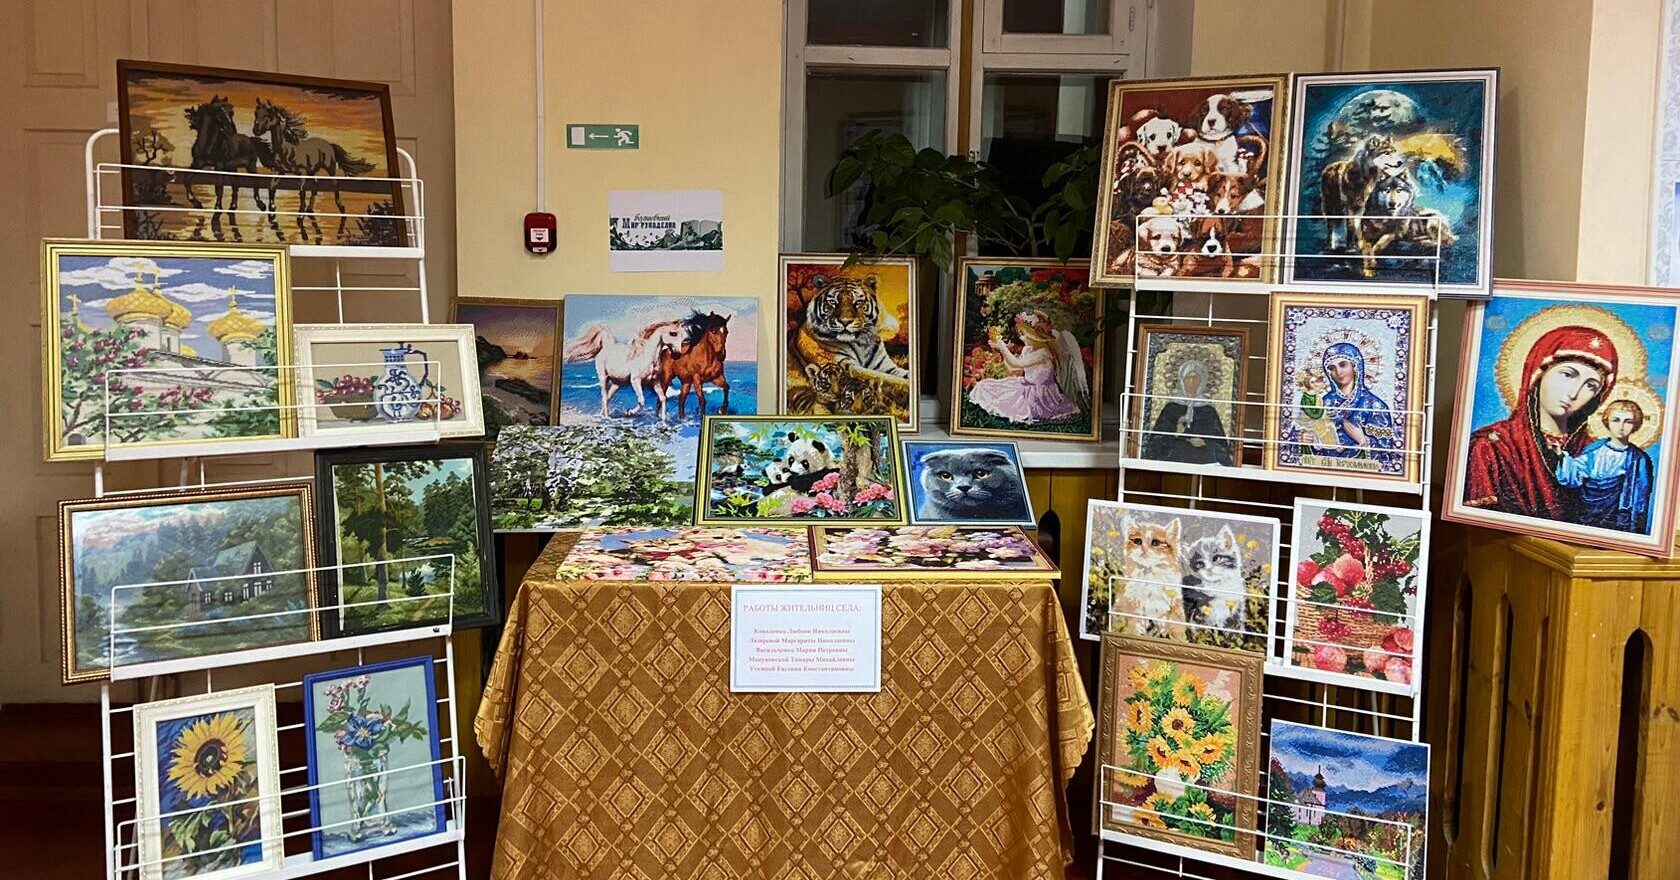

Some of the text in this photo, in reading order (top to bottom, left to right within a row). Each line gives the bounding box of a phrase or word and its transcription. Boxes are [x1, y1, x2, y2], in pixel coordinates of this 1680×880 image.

[743, 604, 862, 613] РАБОТЫ ЖИТЕЛЬНИЦ СЕЛА:
